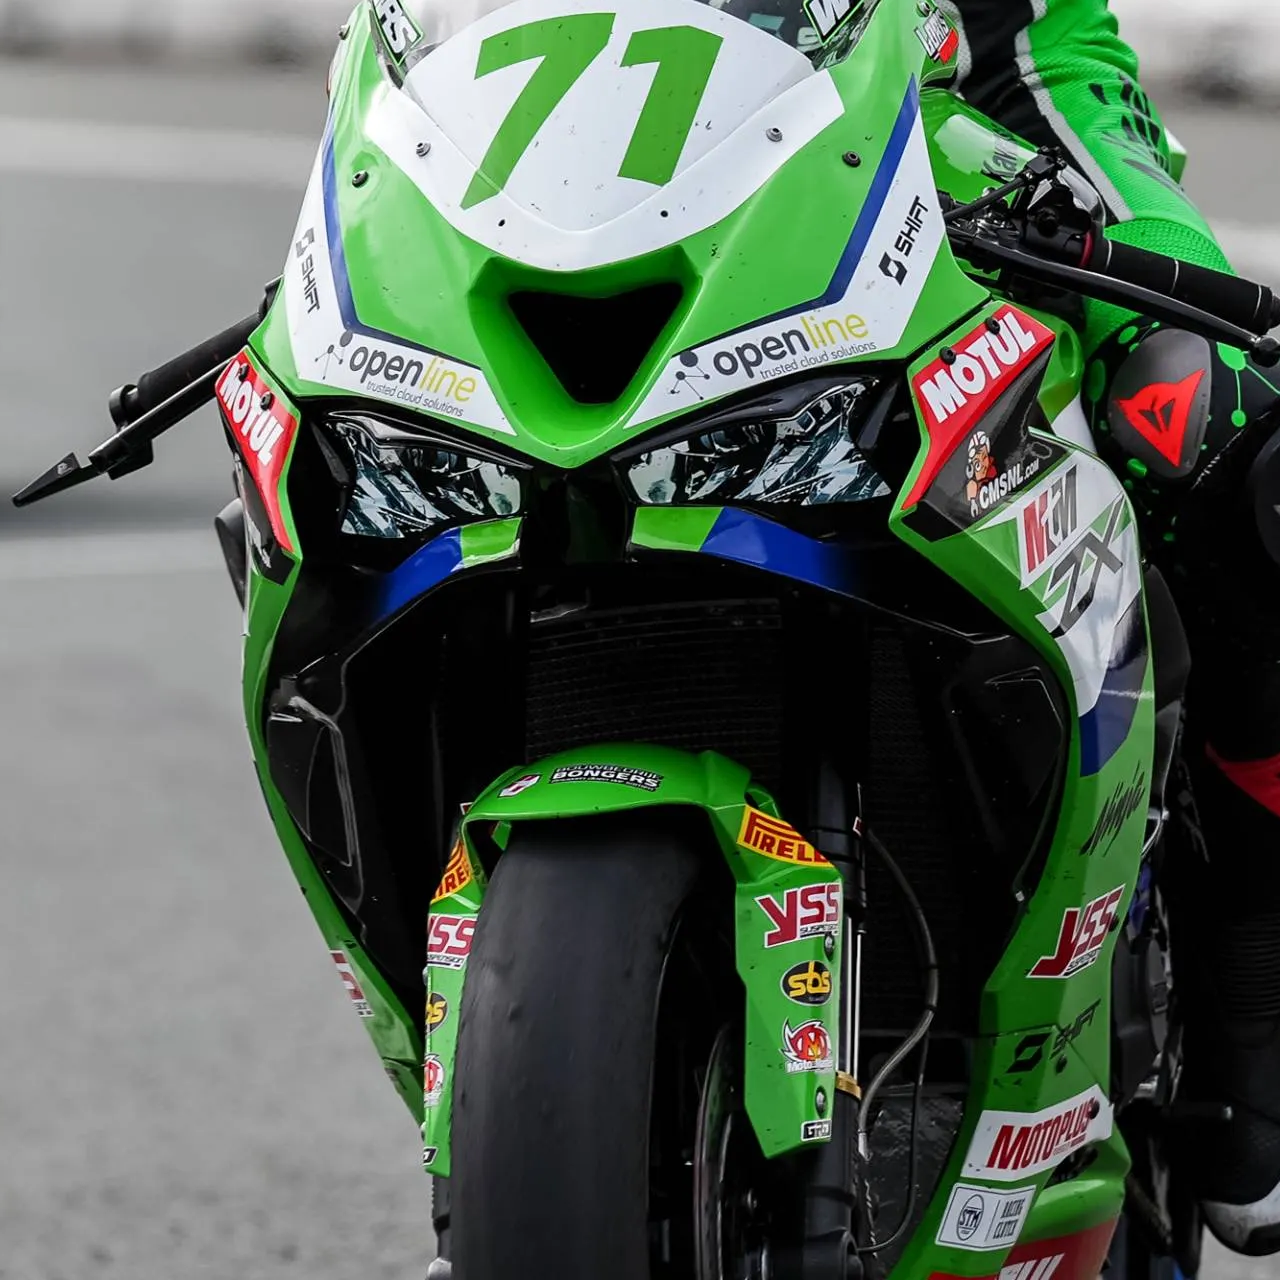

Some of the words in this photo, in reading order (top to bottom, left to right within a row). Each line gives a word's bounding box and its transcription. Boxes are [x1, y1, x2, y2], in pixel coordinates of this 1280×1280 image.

[461, 12, 725, 211] 71
[894, 194, 929, 258] SHIFT
[301, 255, 320, 315] SHIFT
[348, 345, 477, 403] openline
[712, 312, 869, 380] openline
[759, 361, 799, 380] trusted
[800, 353, 829, 368] cloud
[830, 341, 878, 360] solutions
[919, 311, 1037, 424] MOTUL
[219, 359, 285, 466] MOTUL
[366, 380, 397, 397] trusted
[397, 388, 423, 405] cloud
[422, 396, 465, 418] solutions
[552, 769, 660, 789] BONGERS
[428, 915, 478, 957] SS
[757, 883, 841, 948] YSS
[787, 959, 831, 998] sbs
